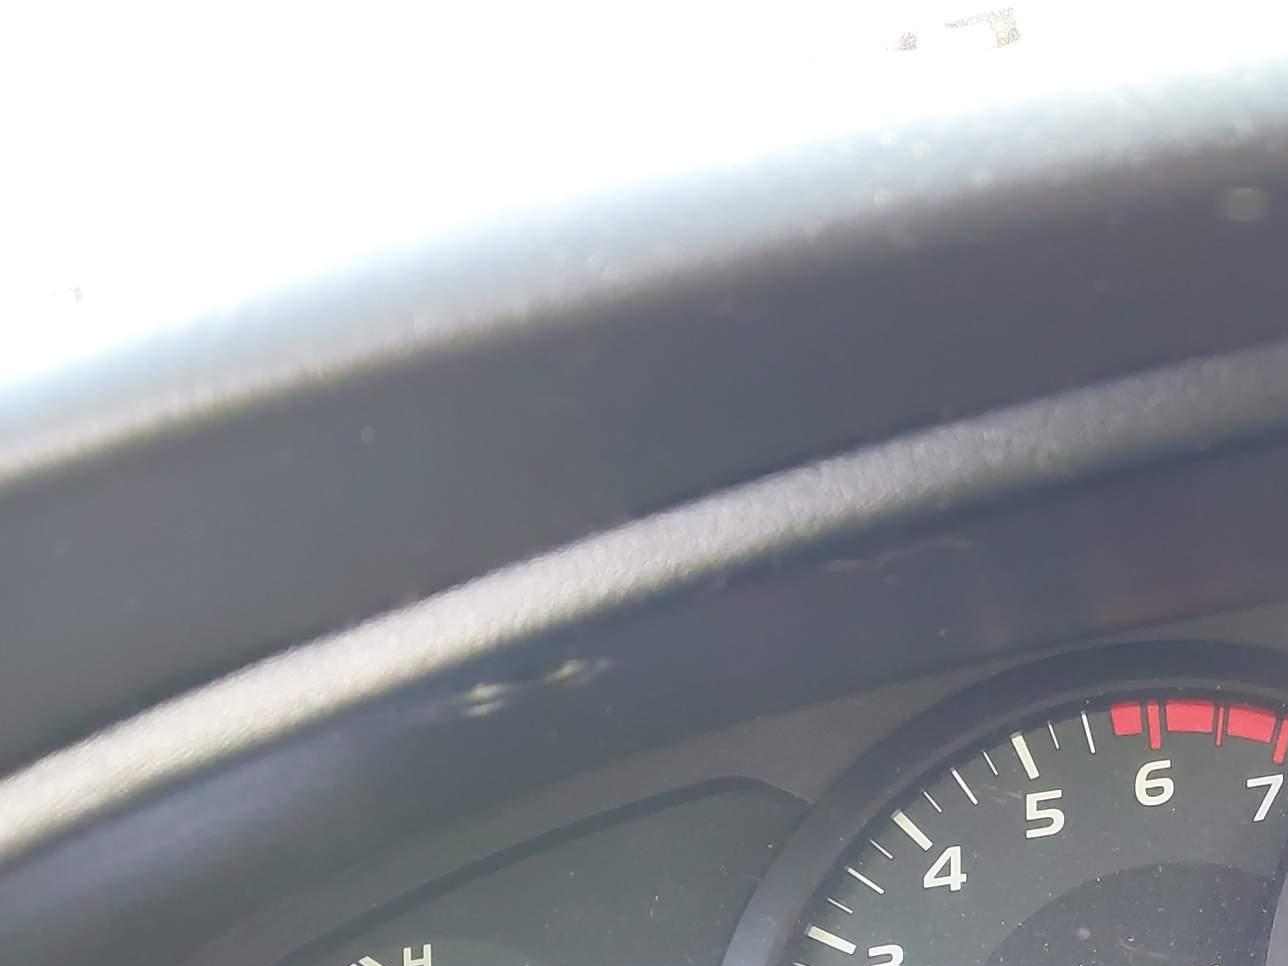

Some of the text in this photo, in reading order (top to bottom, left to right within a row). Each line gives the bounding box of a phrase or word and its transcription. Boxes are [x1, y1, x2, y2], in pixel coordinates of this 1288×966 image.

[1134, 759, 1175, 806] 6
[1246, 774, 1284, 822] 7
[1026, 789, 1065, 839] 5
[922, 844, 967, 891] 4
